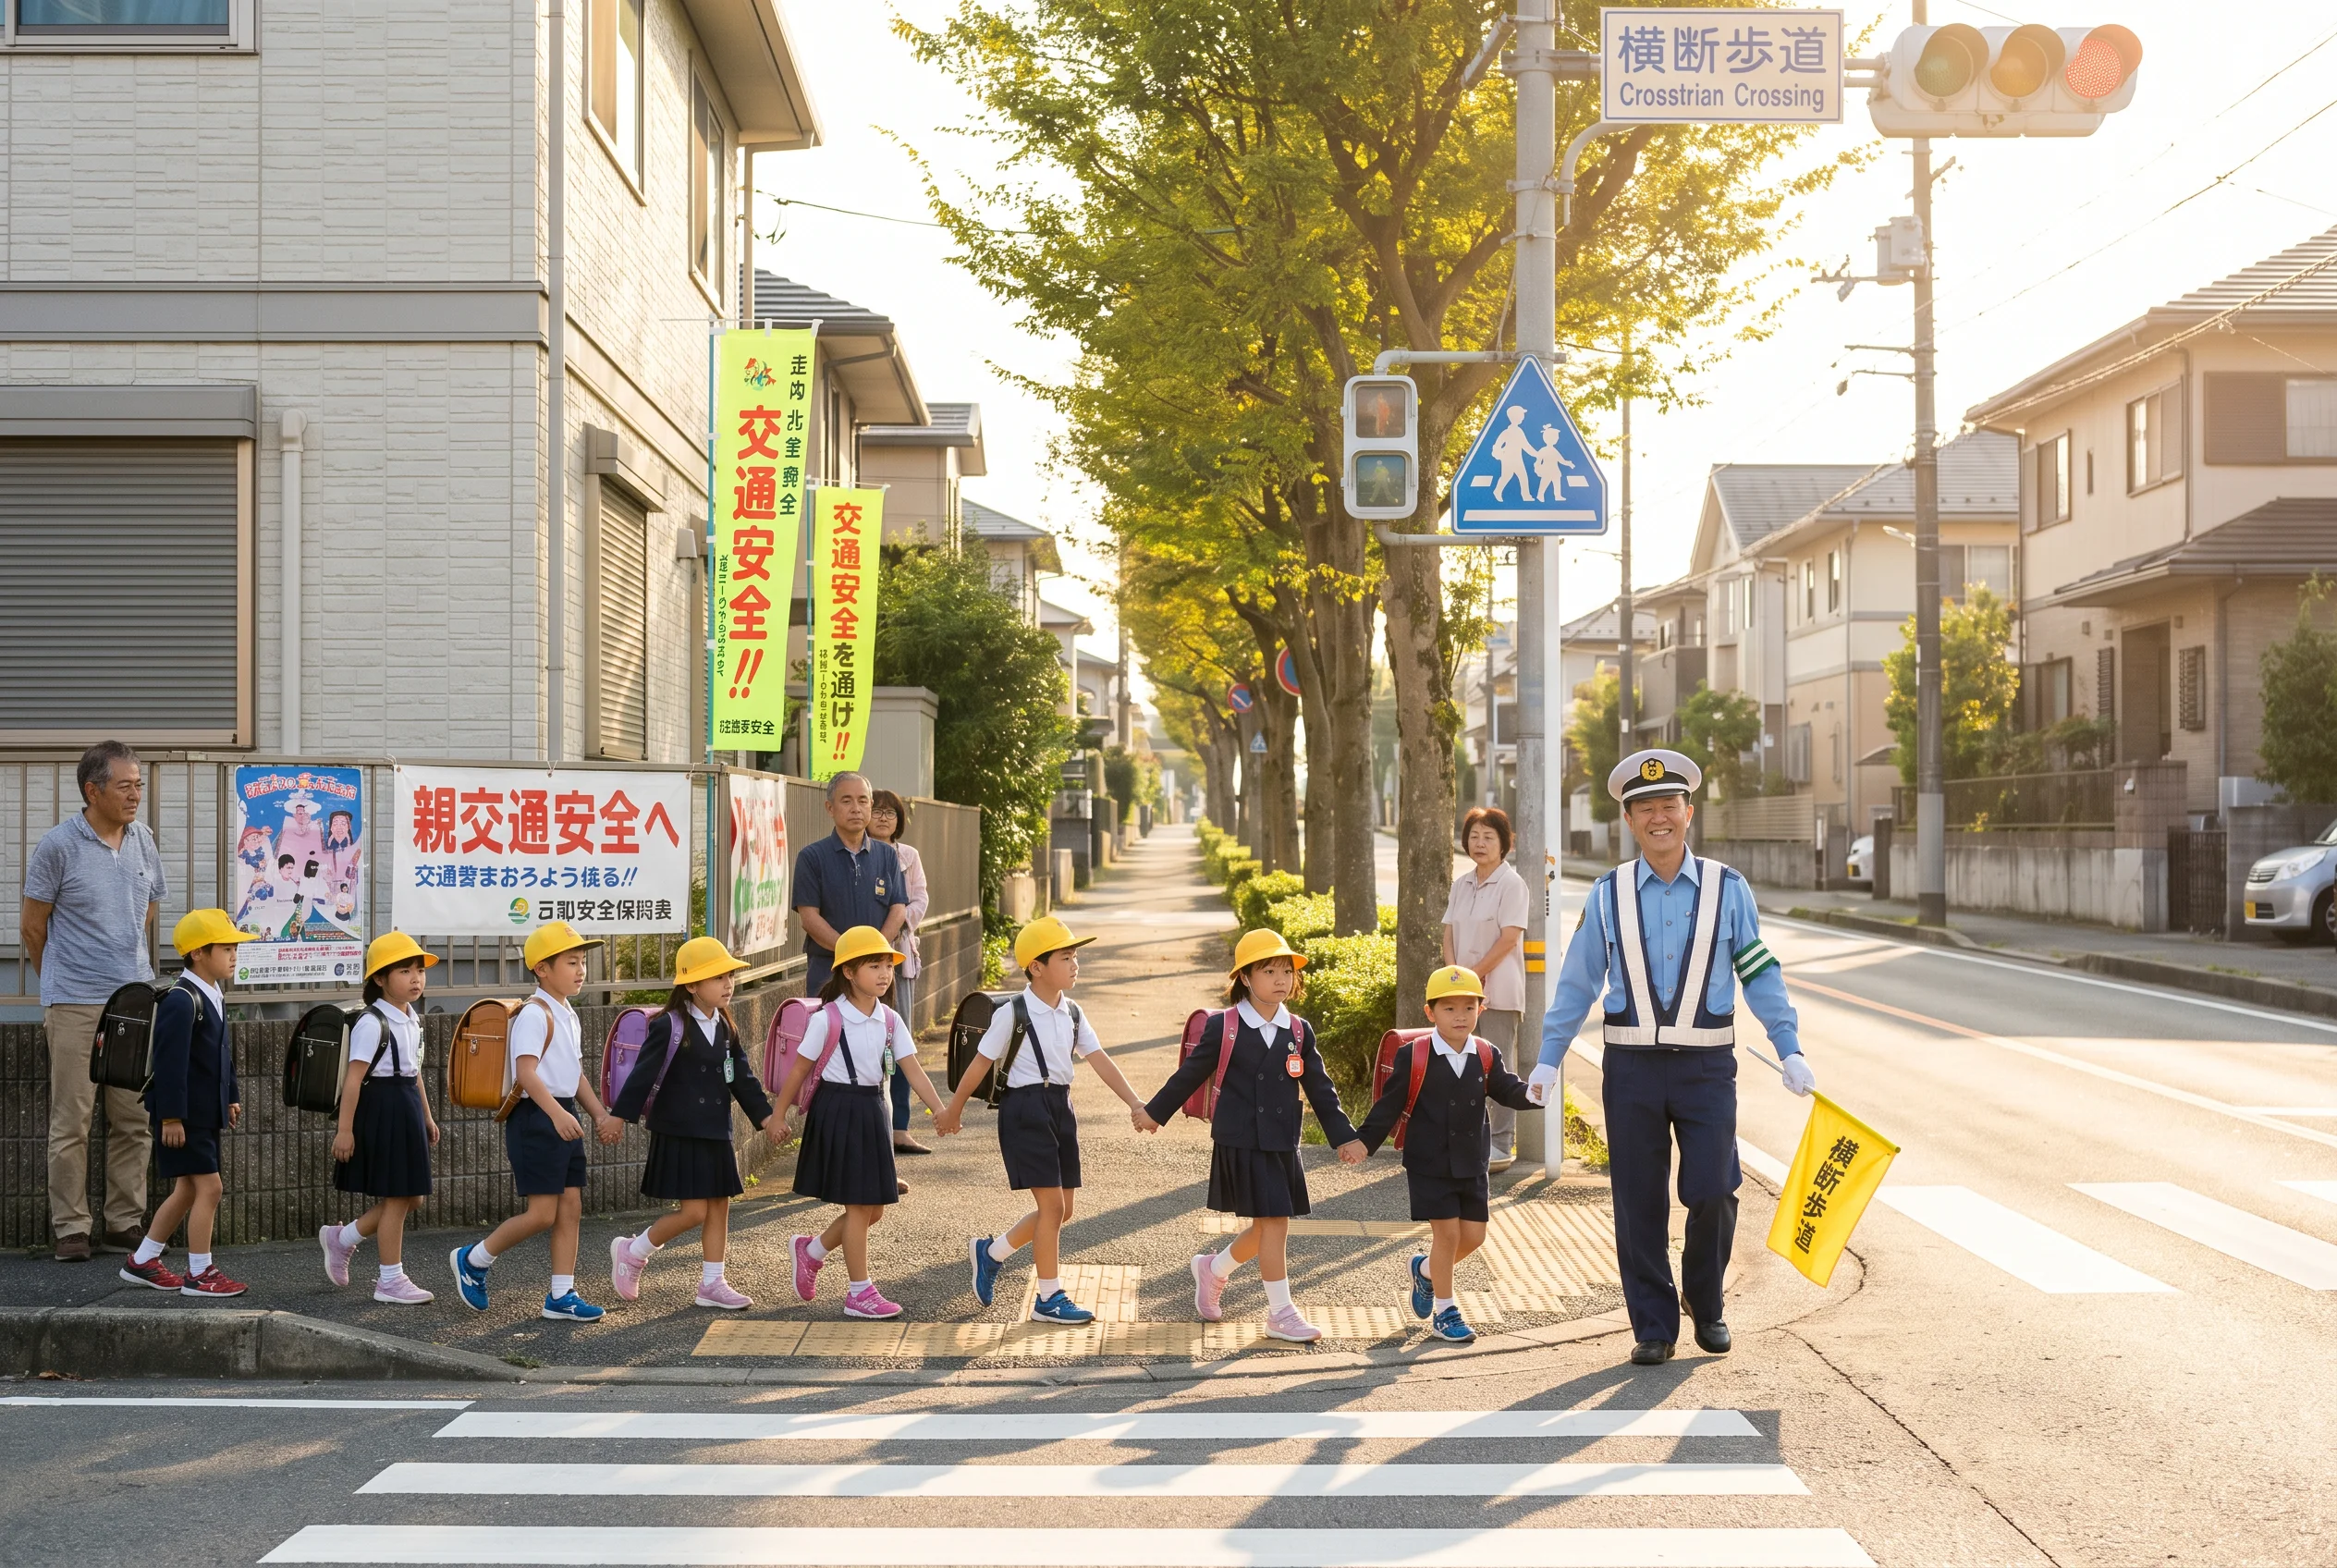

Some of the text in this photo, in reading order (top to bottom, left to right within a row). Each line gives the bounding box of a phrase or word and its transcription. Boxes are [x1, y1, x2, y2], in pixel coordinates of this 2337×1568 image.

[1617, 25, 1827, 74] 横断歩道
[1620, 81, 1825, 114] Crosstrian Crossing
[728, 404, 782, 699] 交通安全!!
[412, 784, 680, 856] 親交通安全へ
[1794, 1135, 1860, 1255] 横断歩道
